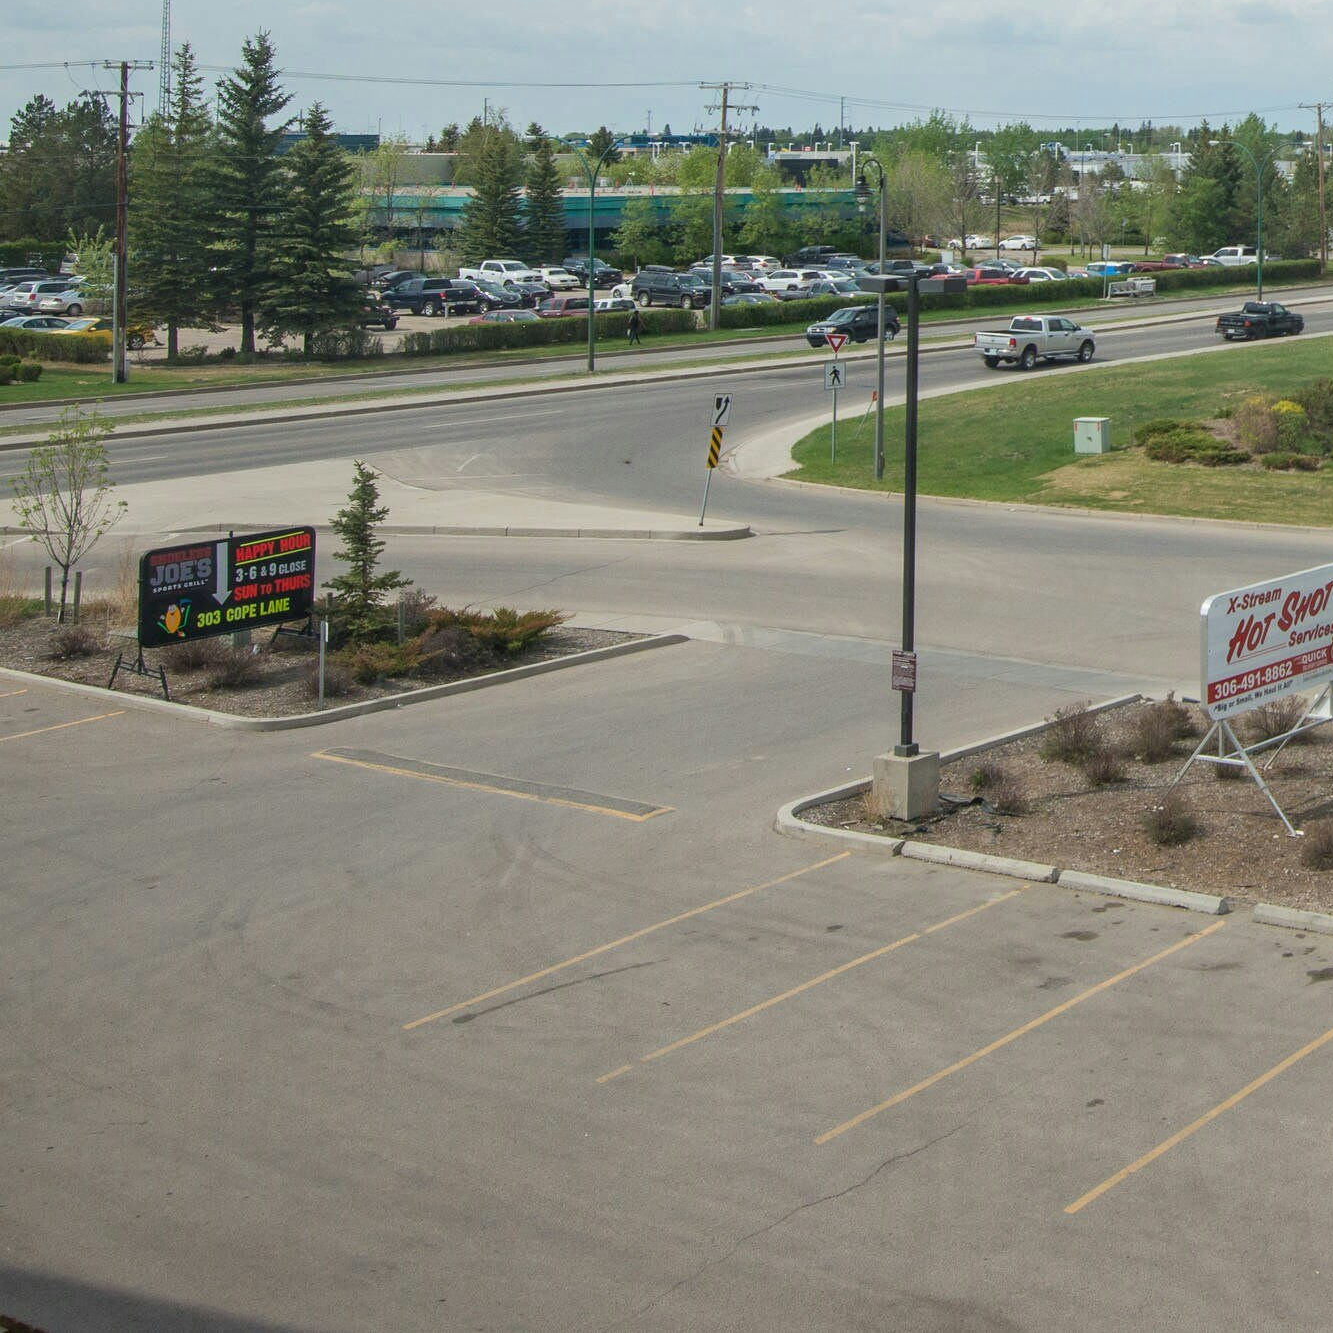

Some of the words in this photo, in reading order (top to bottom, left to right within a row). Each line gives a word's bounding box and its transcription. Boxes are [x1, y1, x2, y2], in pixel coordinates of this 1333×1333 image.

[235, 541, 275, 562] HAPPY
[279, 533, 311, 553] HOUR
[150, 557, 212, 586] JOE'S
[235, 566, 257, 583] 3-6
[260, 565, 267, 577] &
[269, 562, 277, 576] 9
[279, 560, 307, 575] CLOSE
[153, 583, 182, 594] SPORTS
[234, 583, 258, 602] SUN
[260, 583, 272, 595] TO
[274, 573, 311, 594] THURS
[1226, 588, 1282, 615] X-Stream
[197, 609, 221, 629] 303
[226, 602, 257, 623] COPE
[260, 597, 291, 617] LANE
[1226, 612, 1276, 664] HOT
[1302, 648, 1328, 665] QUICK
[1214, 661, 1293, 700] 306-491-8862
